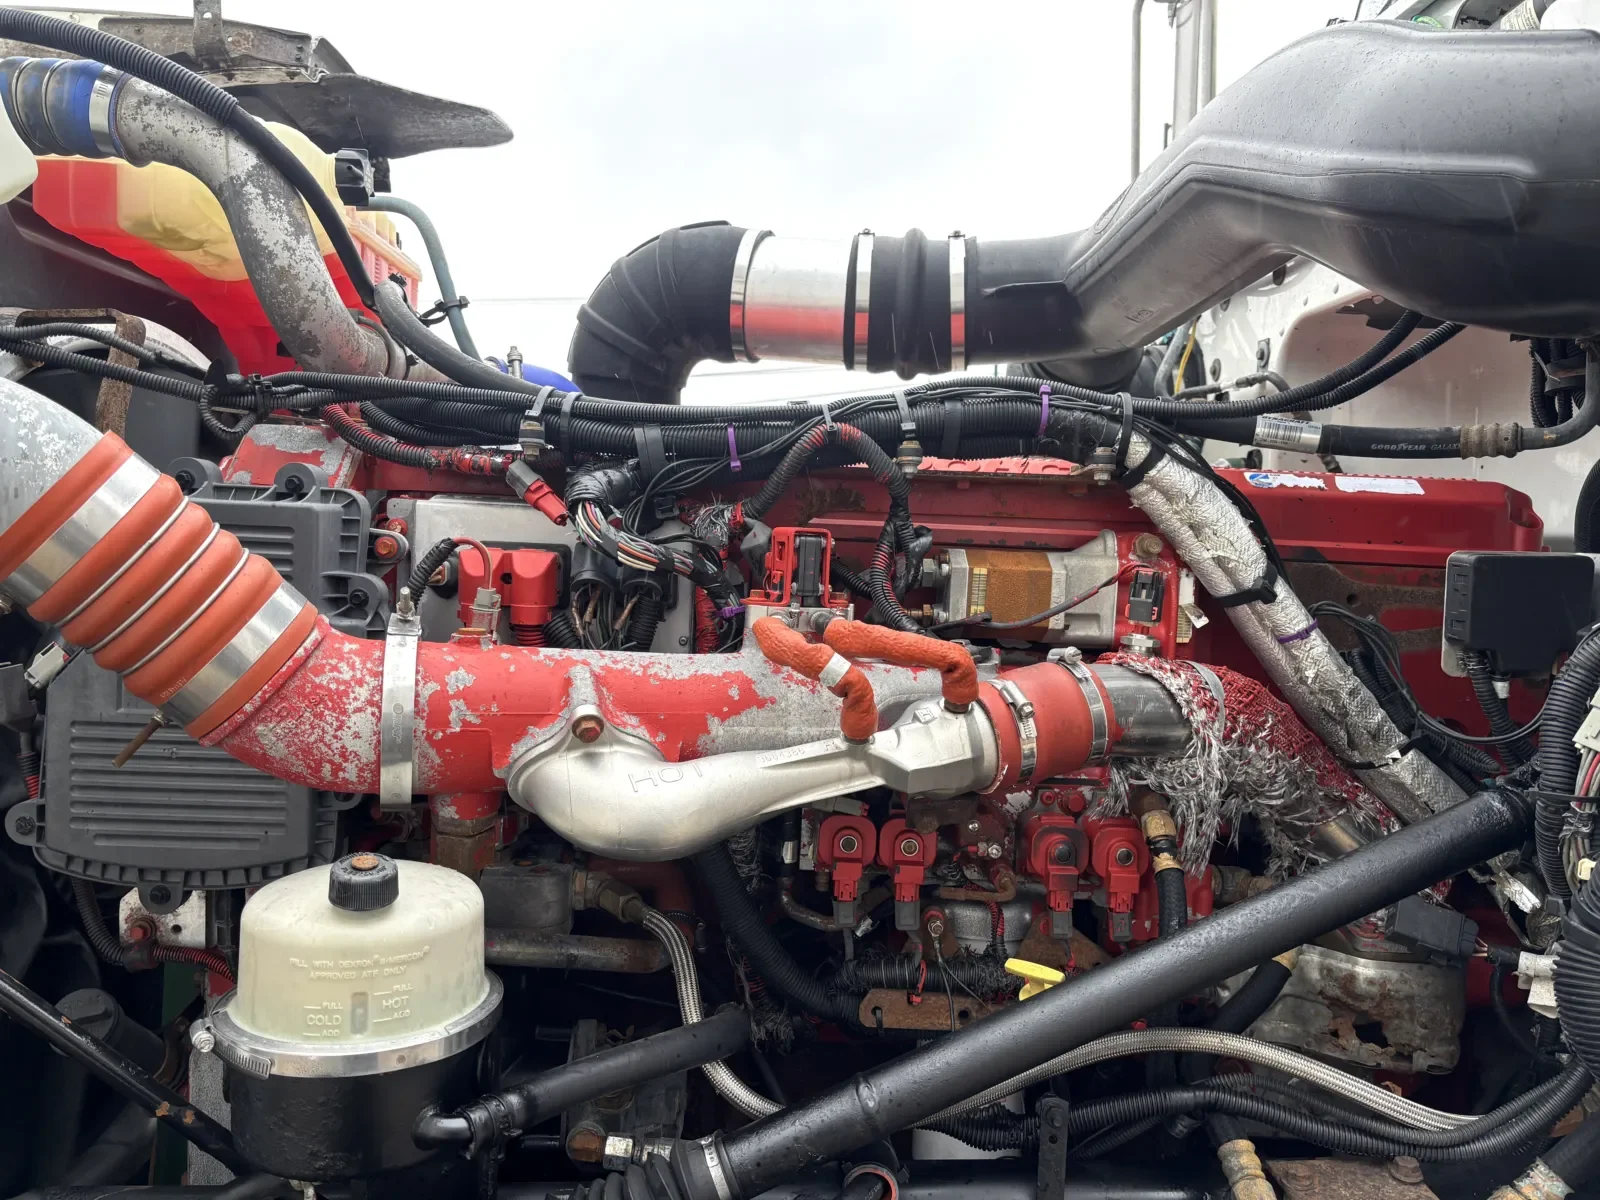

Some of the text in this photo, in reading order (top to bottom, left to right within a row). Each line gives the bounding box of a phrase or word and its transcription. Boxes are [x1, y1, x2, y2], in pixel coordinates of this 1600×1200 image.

[1370, 442, 1427, 451] GOODYEAR
[312, 960, 334, 968] WITH
[308, 970, 356, 980] APPROVED
[383, 965, 407, 976] ONLY
[393, 983, 413, 992] FULL
[322, 1001, 344, 1010] FULL
[382, 995, 410, 1009] HOT
[306, 1014, 342, 1026] COLD
[322, 1029, 341, 1037] ADD
